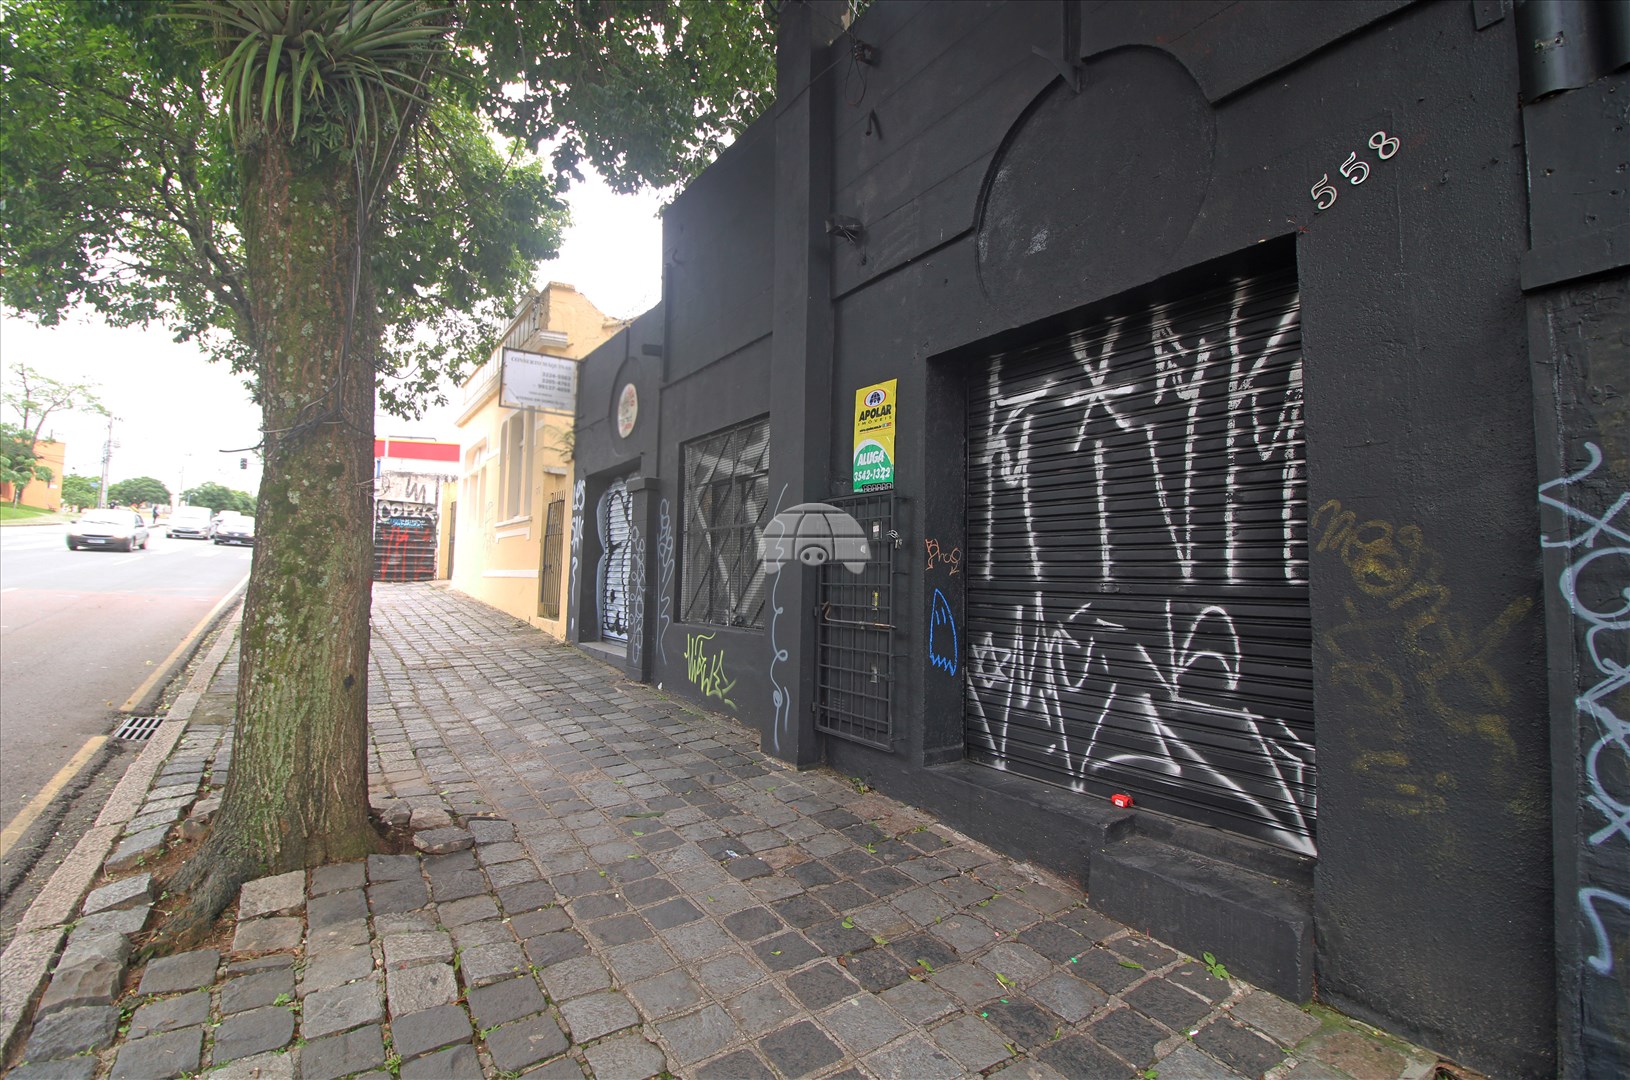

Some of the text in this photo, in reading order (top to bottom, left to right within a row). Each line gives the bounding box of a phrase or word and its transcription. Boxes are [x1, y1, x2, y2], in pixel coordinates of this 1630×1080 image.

[1310, 131, 1400, 210] 558
[859, 404, 892, 421] APOLAR
[857, 450, 885, 466] ALUGA
[853, 467, 891, 482] 3542-1322
